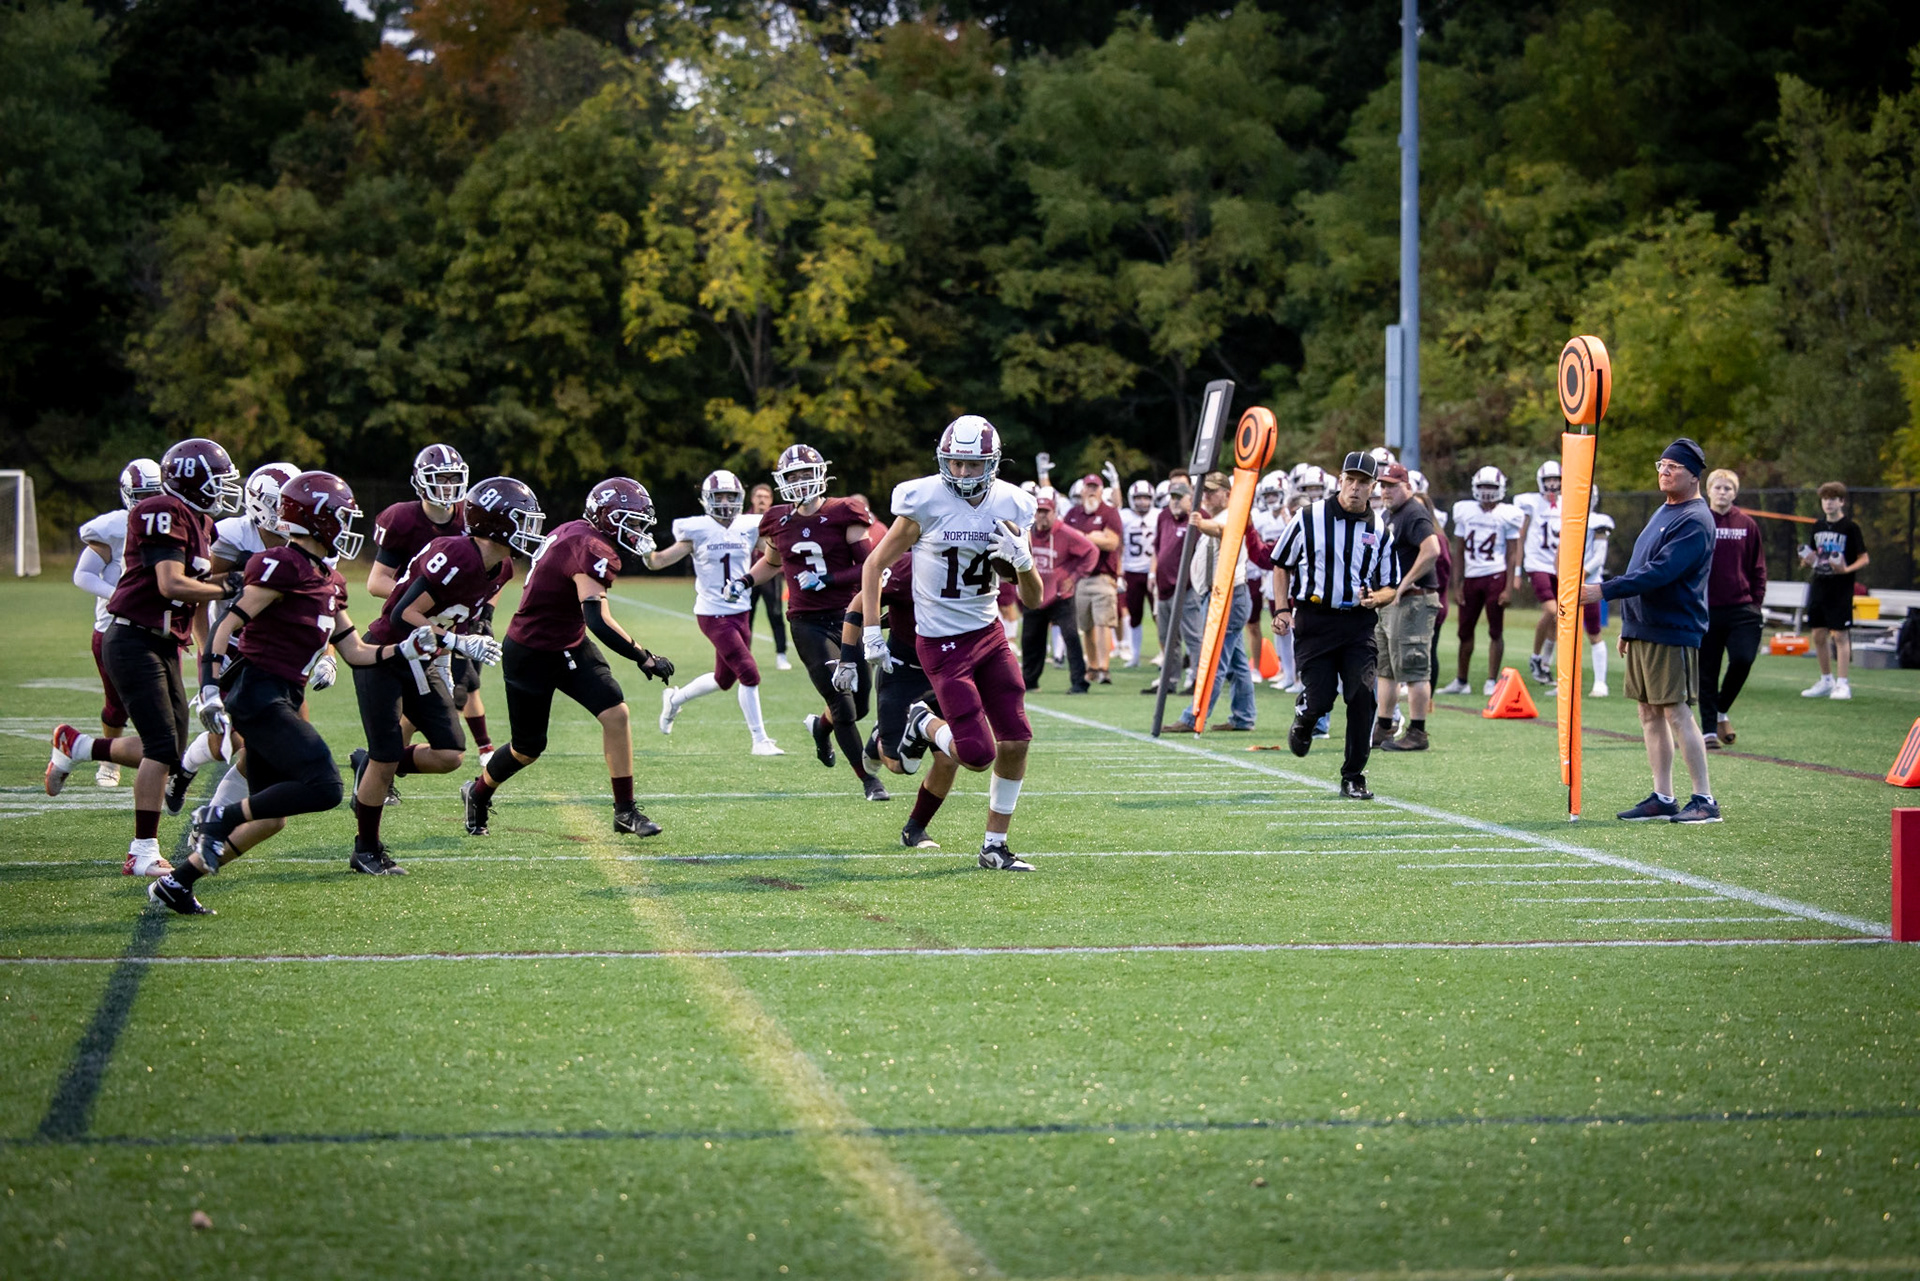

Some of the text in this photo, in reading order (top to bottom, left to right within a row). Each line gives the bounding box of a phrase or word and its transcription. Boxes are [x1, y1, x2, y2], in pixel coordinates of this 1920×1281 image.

[173, 457, 196, 478] 78
[312, 491, 329, 515] 7
[479, 487, 502, 512] 81
[600, 489, 616, 505] 4
[141, 511, 172, 536] 78
[1464, 529, 1498, 561] 44
[260, 557, 280, 582] 7
[426, 552, 460, 586] 81
[593, 557, 609, 578] 4
[790, 541, 828, 577] 3
[720, 552, 732, 594] 1
[939, 546, 993, 599] 14
[301, 614, 336, 676] 7
